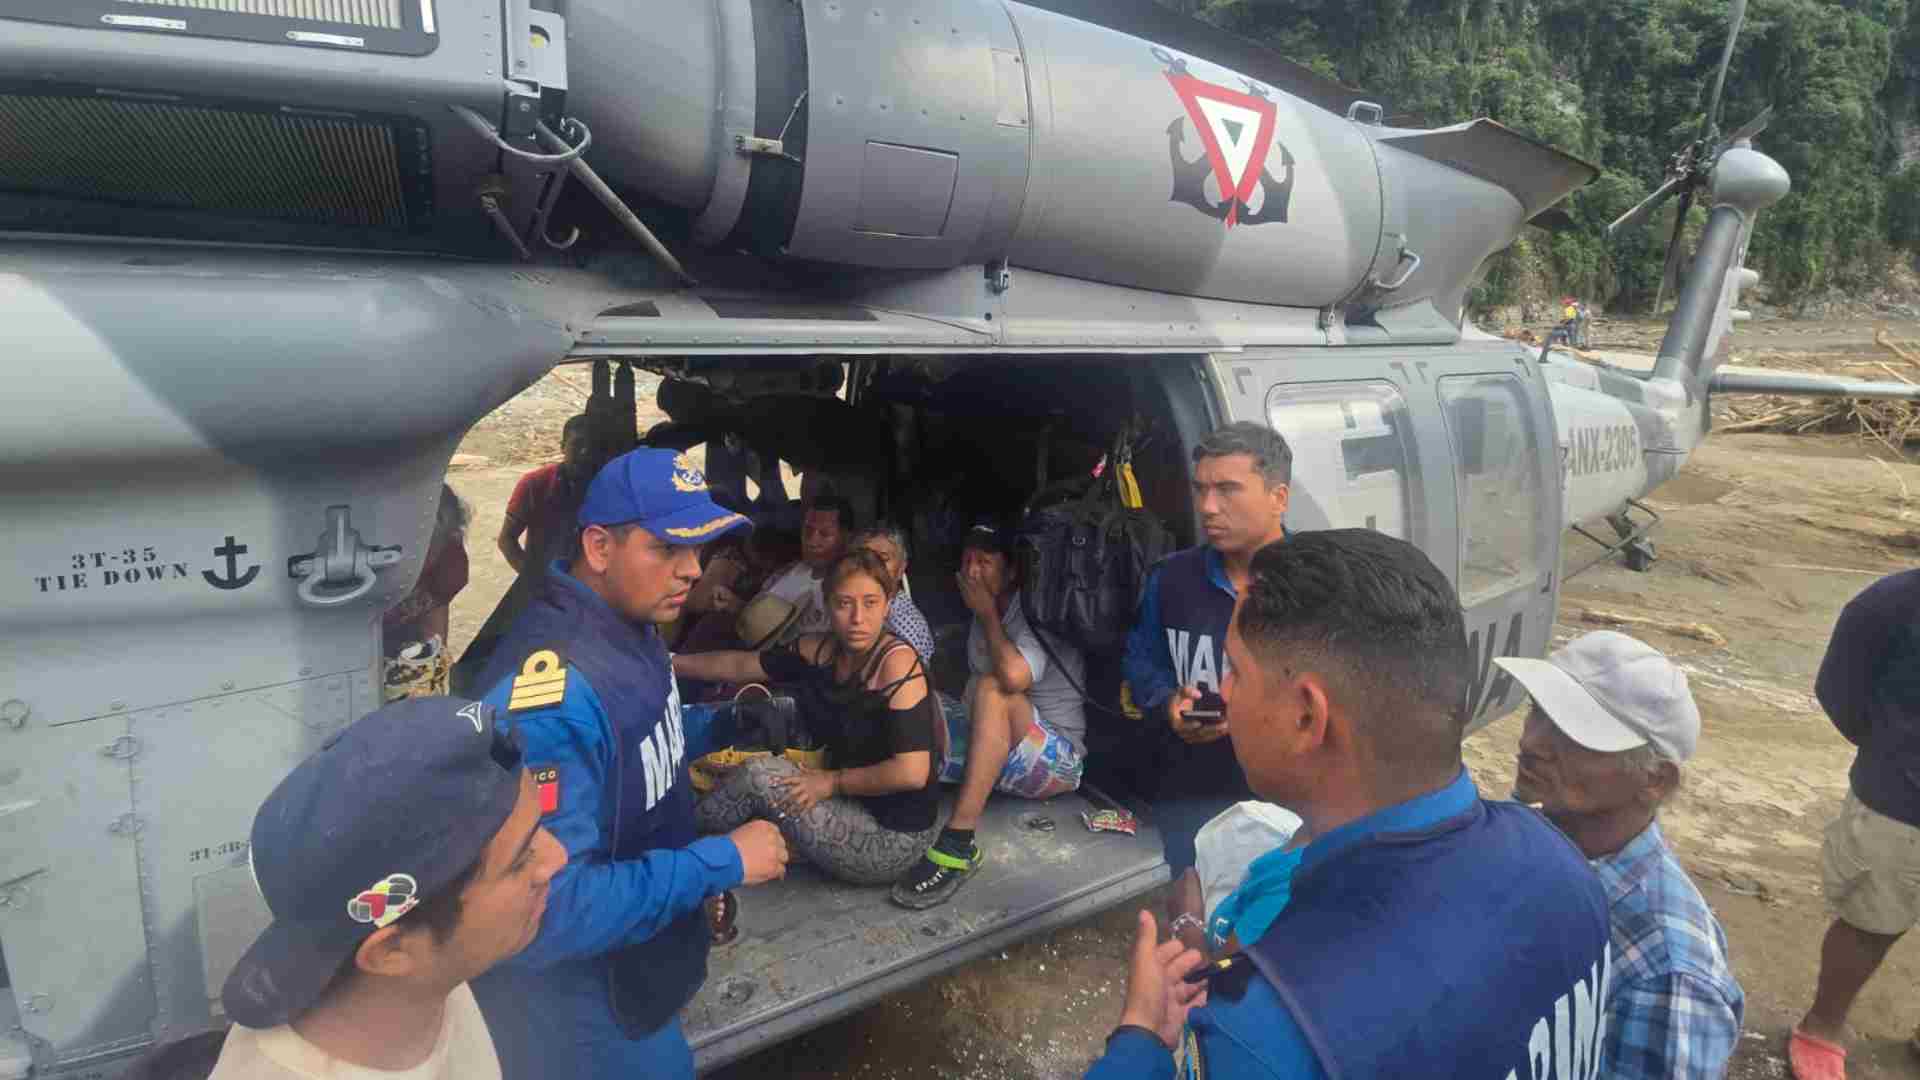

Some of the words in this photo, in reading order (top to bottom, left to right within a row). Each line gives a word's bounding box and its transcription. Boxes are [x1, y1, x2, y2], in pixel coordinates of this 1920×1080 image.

[72, 546, 156, 569] 3T-35
[34, 572, 88, 592] TIE
[104, 562, 188, 585] DOWN
